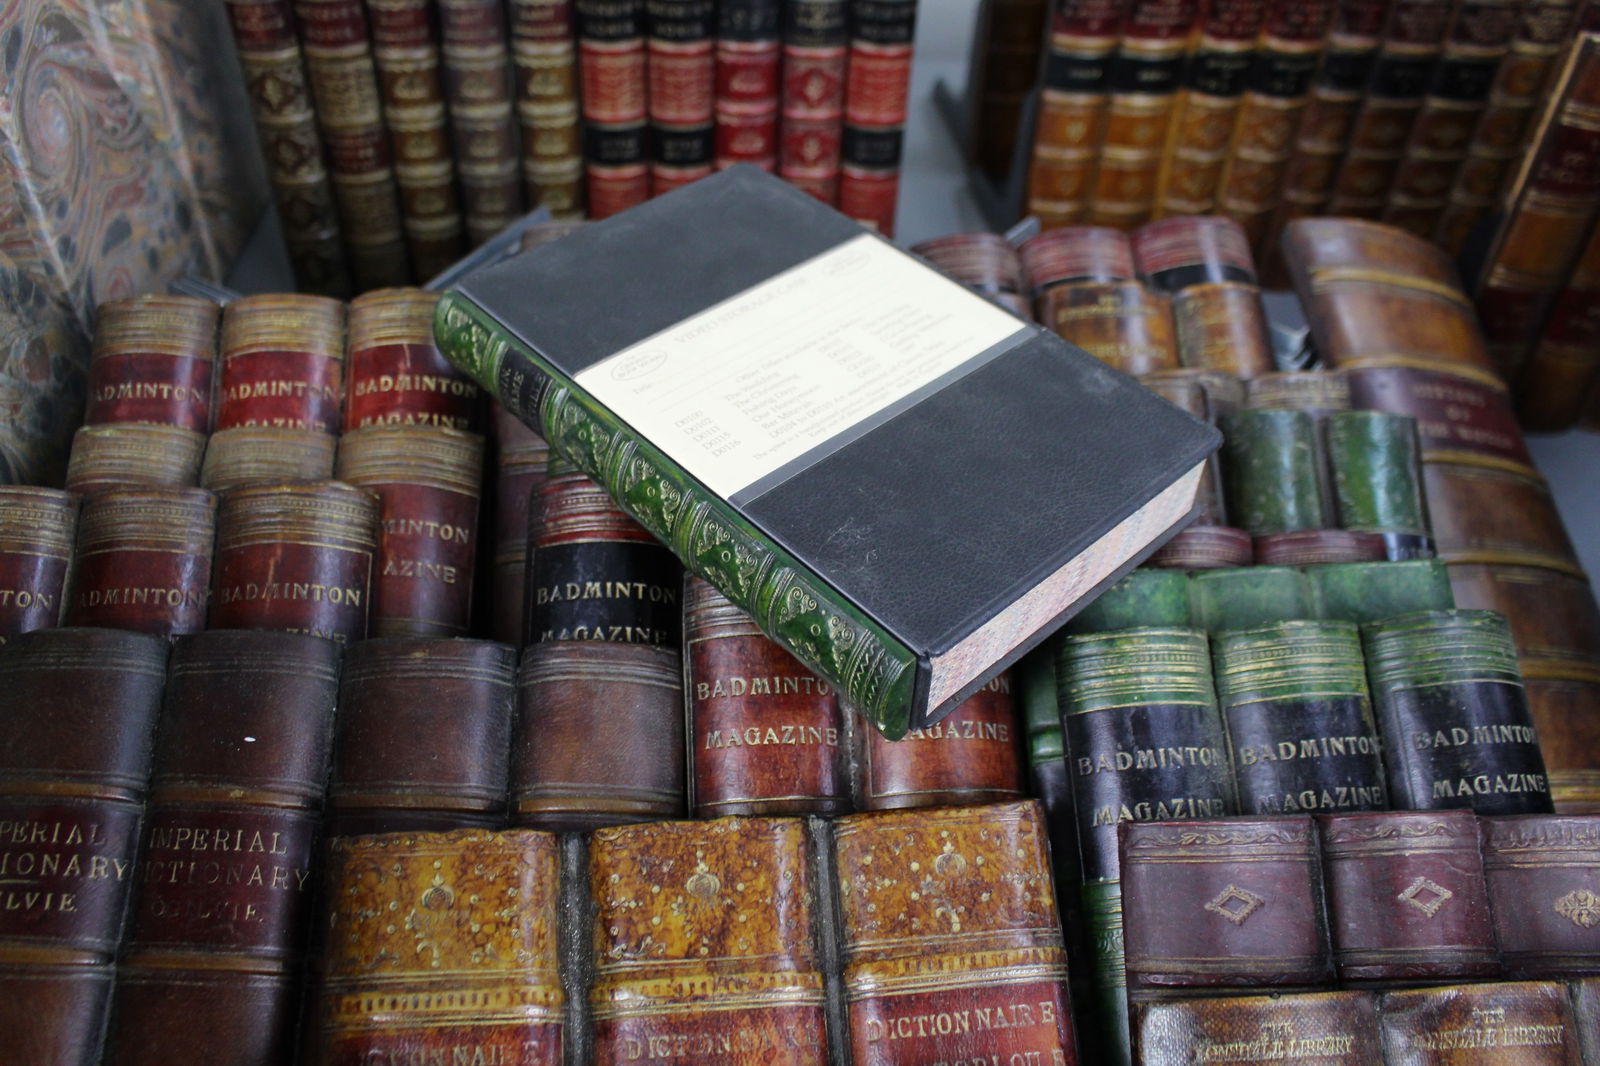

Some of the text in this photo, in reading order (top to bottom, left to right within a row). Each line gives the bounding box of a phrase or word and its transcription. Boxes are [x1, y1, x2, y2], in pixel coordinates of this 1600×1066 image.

[97, 380, 203, 401] ADMINTON
[223, 379, 335, 400] ADMINTON
[381, 518, 470, 543] MINTON
[383, 559, 456, 584] AZINE
[80, 587, 200, 608] ADMINTON
[221, 582, 361, 607] BADMINTON
[537, 581, 676, 605] BADMINTON
[697, 676, 838, 700] BADMINTO
[705, 724, 839, 750] MAGAZINE
[1413, 725, 1537, 751] BADMINTON
[1078, 744, 1226, 776] BADMINTON
[1241, 735, 1384, 766] BADMINTON
[1432, 773, 1547, 800] MAGAZINE
[1091, 797, 1224, 827] MAGAZINE
[1259, 786, 1383, 815] MAGAZINE
[0, 820, 106, 847] PERIAL
[150, 827, 288, 855] IMPERIAL
[0, 852, 128, 881] IONARY
[866, 1001, 1056, 1043] DICTIONNAIRE
